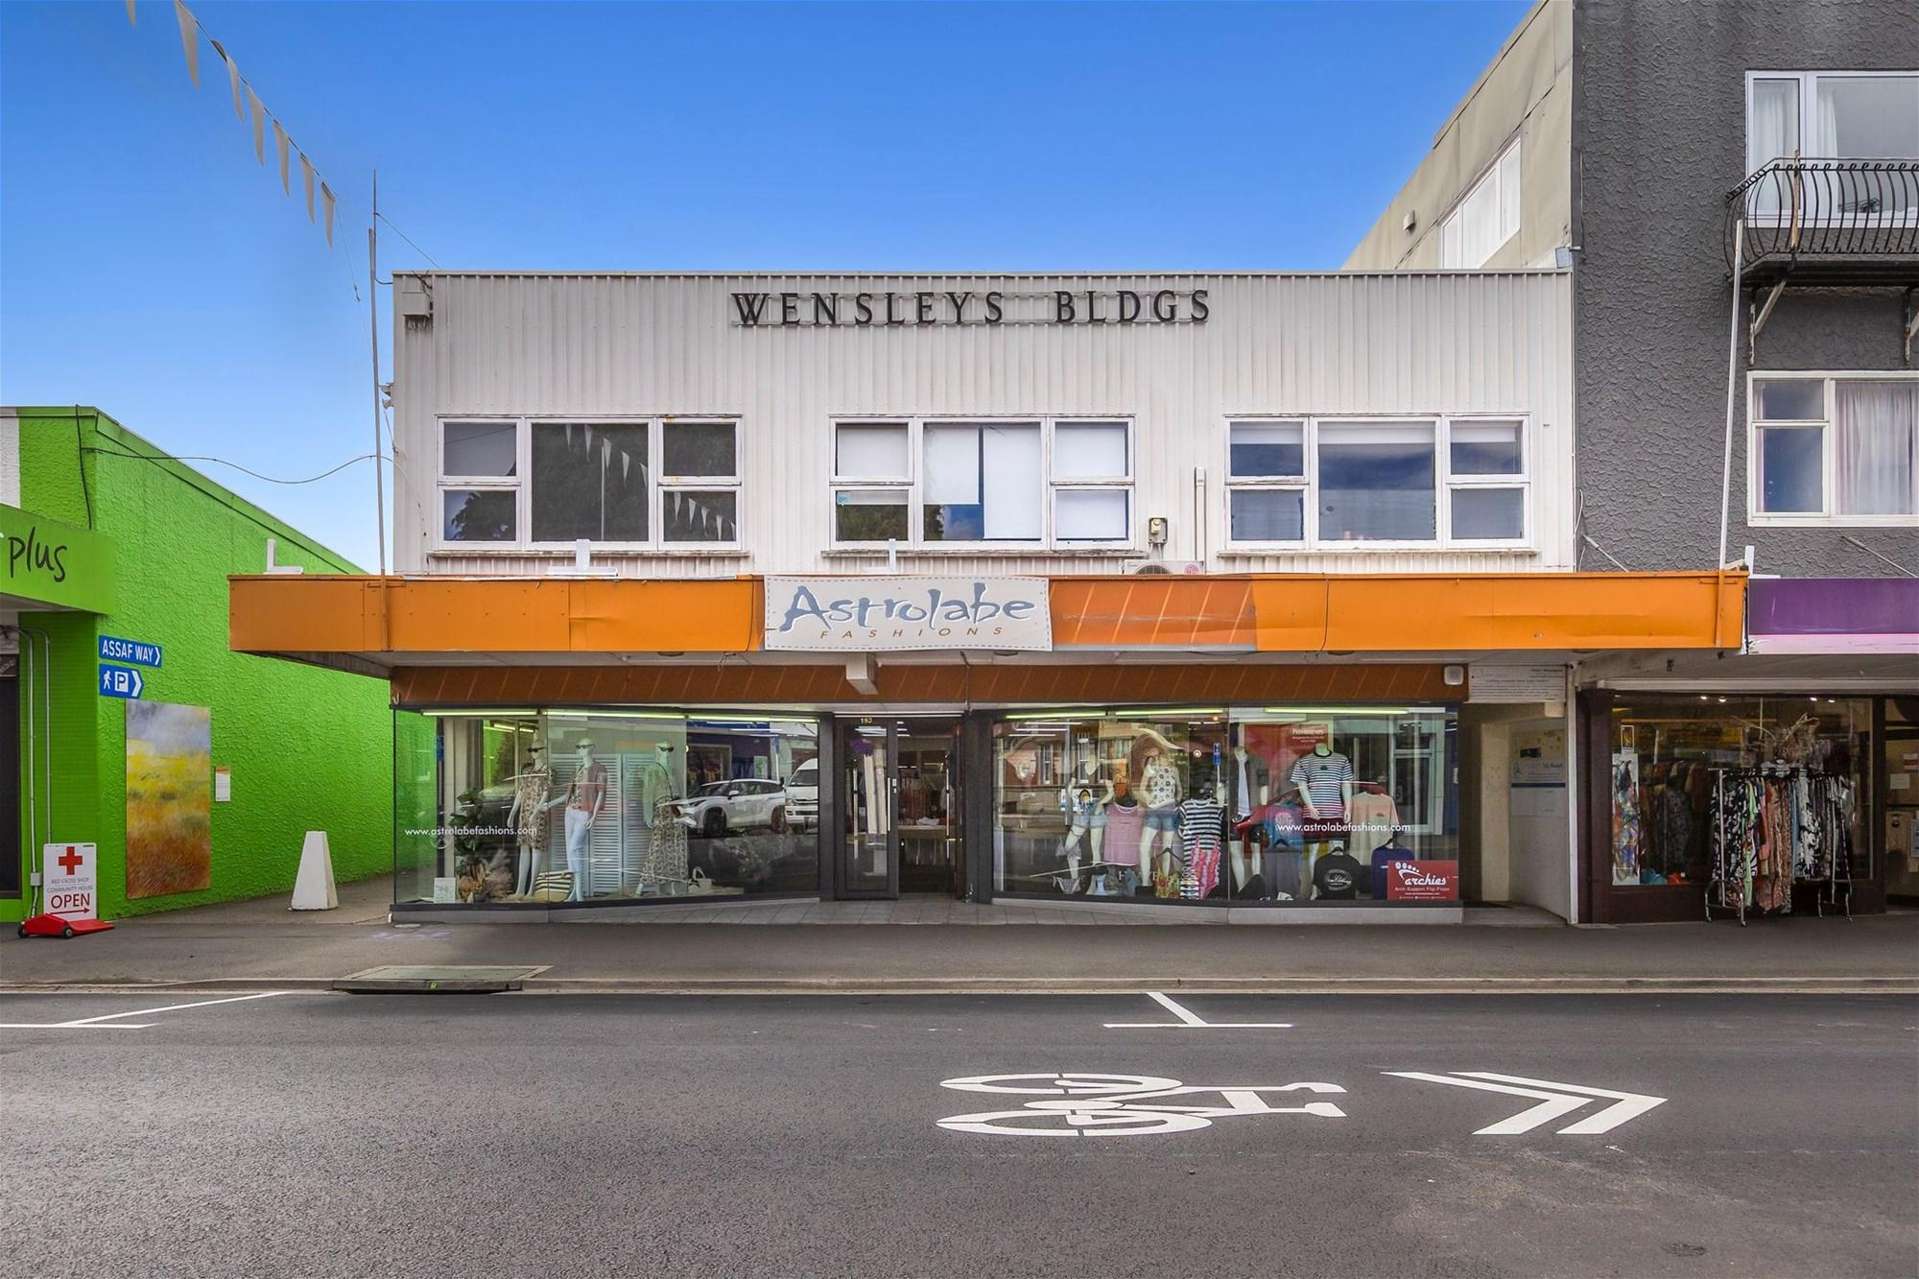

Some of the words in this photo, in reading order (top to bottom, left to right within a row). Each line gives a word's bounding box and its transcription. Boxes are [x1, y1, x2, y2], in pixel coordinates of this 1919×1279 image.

[731, 290, 1003, 326] WENSLEYS
[1054, 289, 1209, 324] BLDGS
[8, 526, 68, 583] plus
[779, 582, 1035, 632] Astrolabe
[819, 626, 1003, 639] FASHIONS
[102, 639, 133, 659] ASSAF
[134, 645, 154, 663] WAY
[117, 674, 127, 690] P
[404, 826, 538, 836] www.astrolabefashions.com
[1275, 821, 1411, 832] www.astrolabefashions.com
[1404, 872, 1447, 886] archies
[51, 893, 90, 909] OPEN
